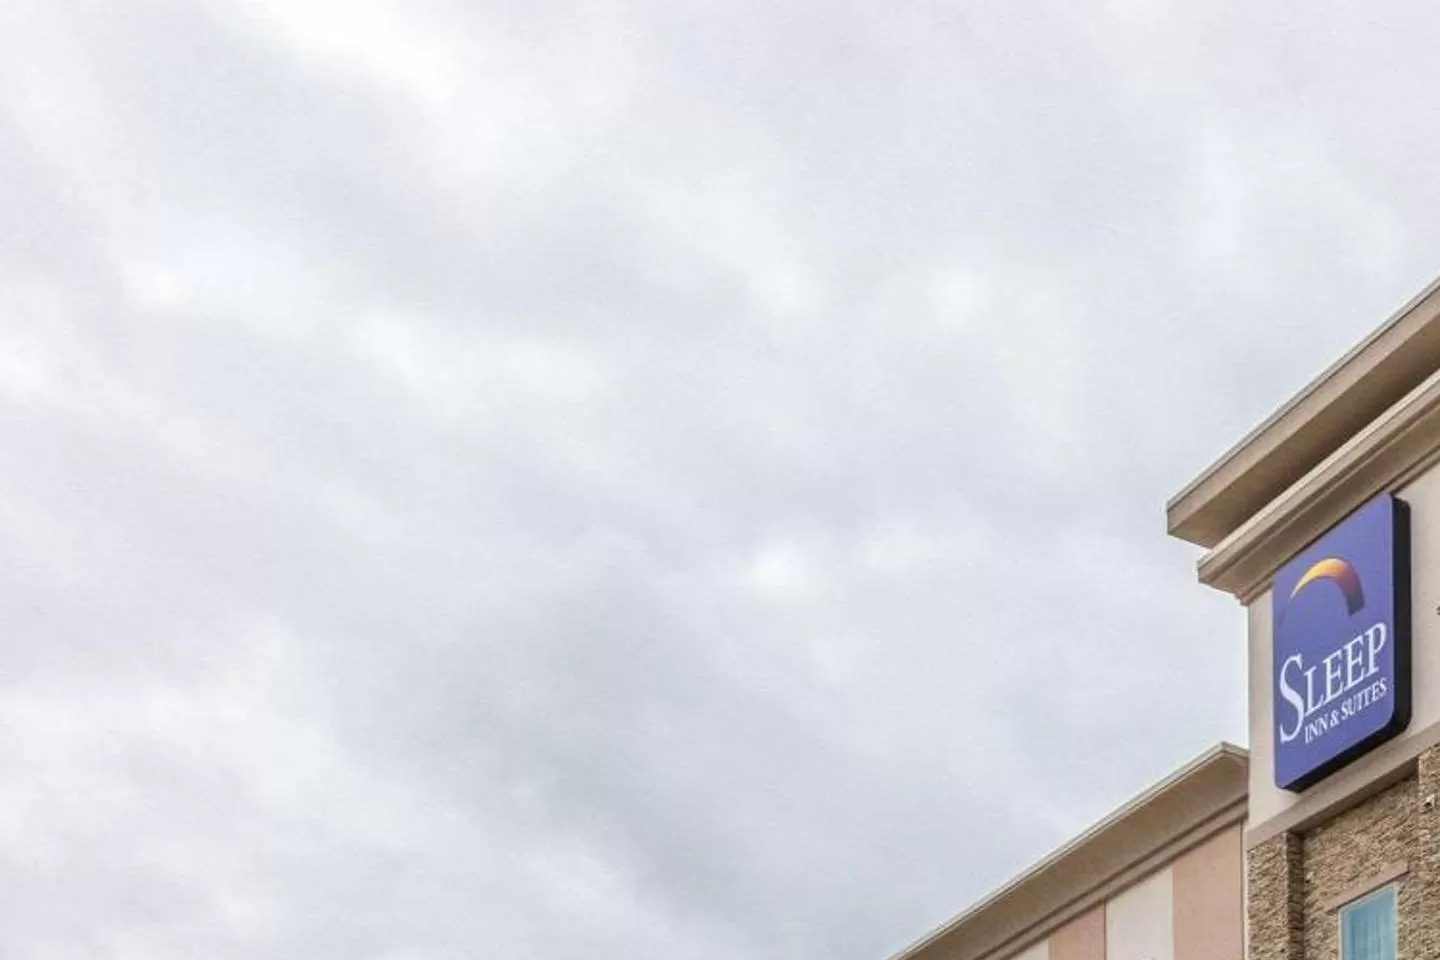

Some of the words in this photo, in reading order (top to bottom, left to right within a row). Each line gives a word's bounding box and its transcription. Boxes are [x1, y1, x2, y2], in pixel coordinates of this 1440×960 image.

[1280, 622, 1387, 744] SLEEP
[1304, 713, 1328, 744] INN
[1330, 709, 1340, 727] &
[1341, 677, 1388, 721] SUITES
